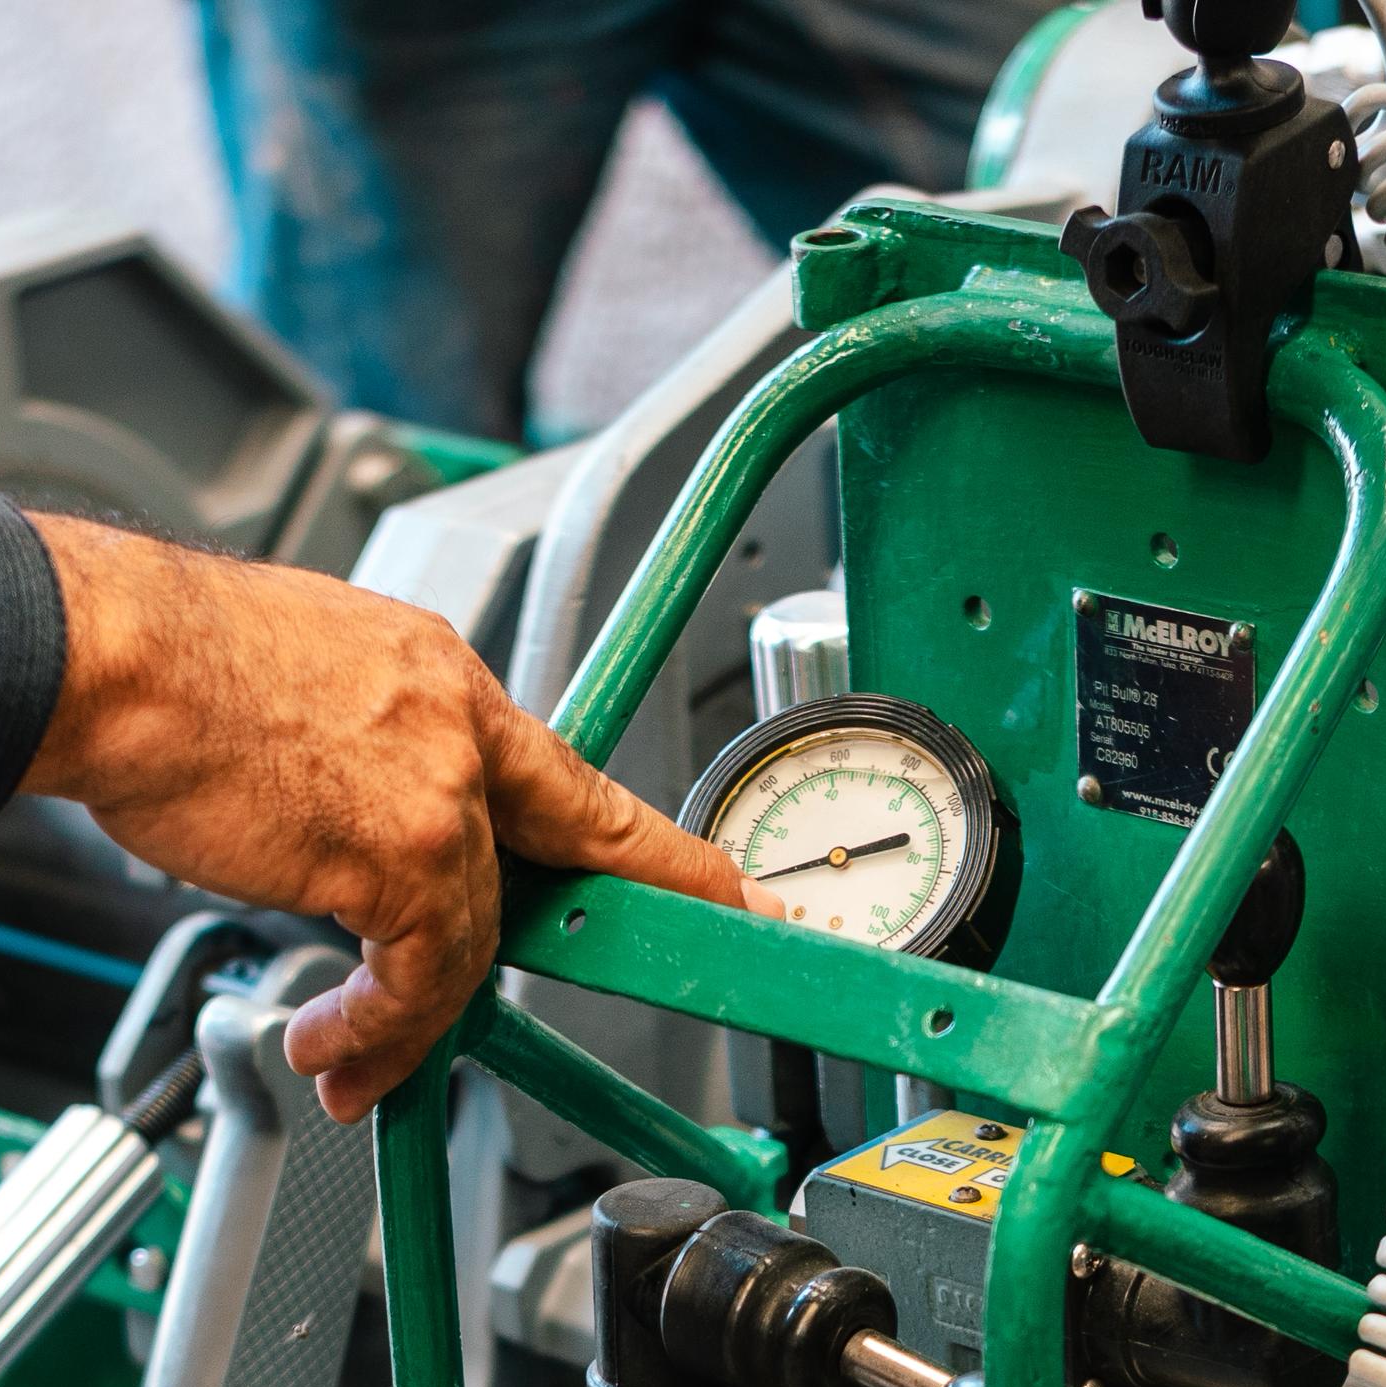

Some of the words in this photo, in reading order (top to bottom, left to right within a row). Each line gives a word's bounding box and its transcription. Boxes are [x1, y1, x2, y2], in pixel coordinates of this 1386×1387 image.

[830, 749, 850, 762] 600
[901, 754, 922, 771] 800
[758, 774, 778, 794] 400
[824, 787, 839, 802] 40
[888, 799, 902, 812] 60
[946, 792, 963, 817] 1000
[773, 826, 789, 840] 20
[907, 852, 921, 865] 80
[869, 903, 891, 920] 100
[867, 924, 886, 937] bar
[897, 1147, 961, 1169] CLOSE
